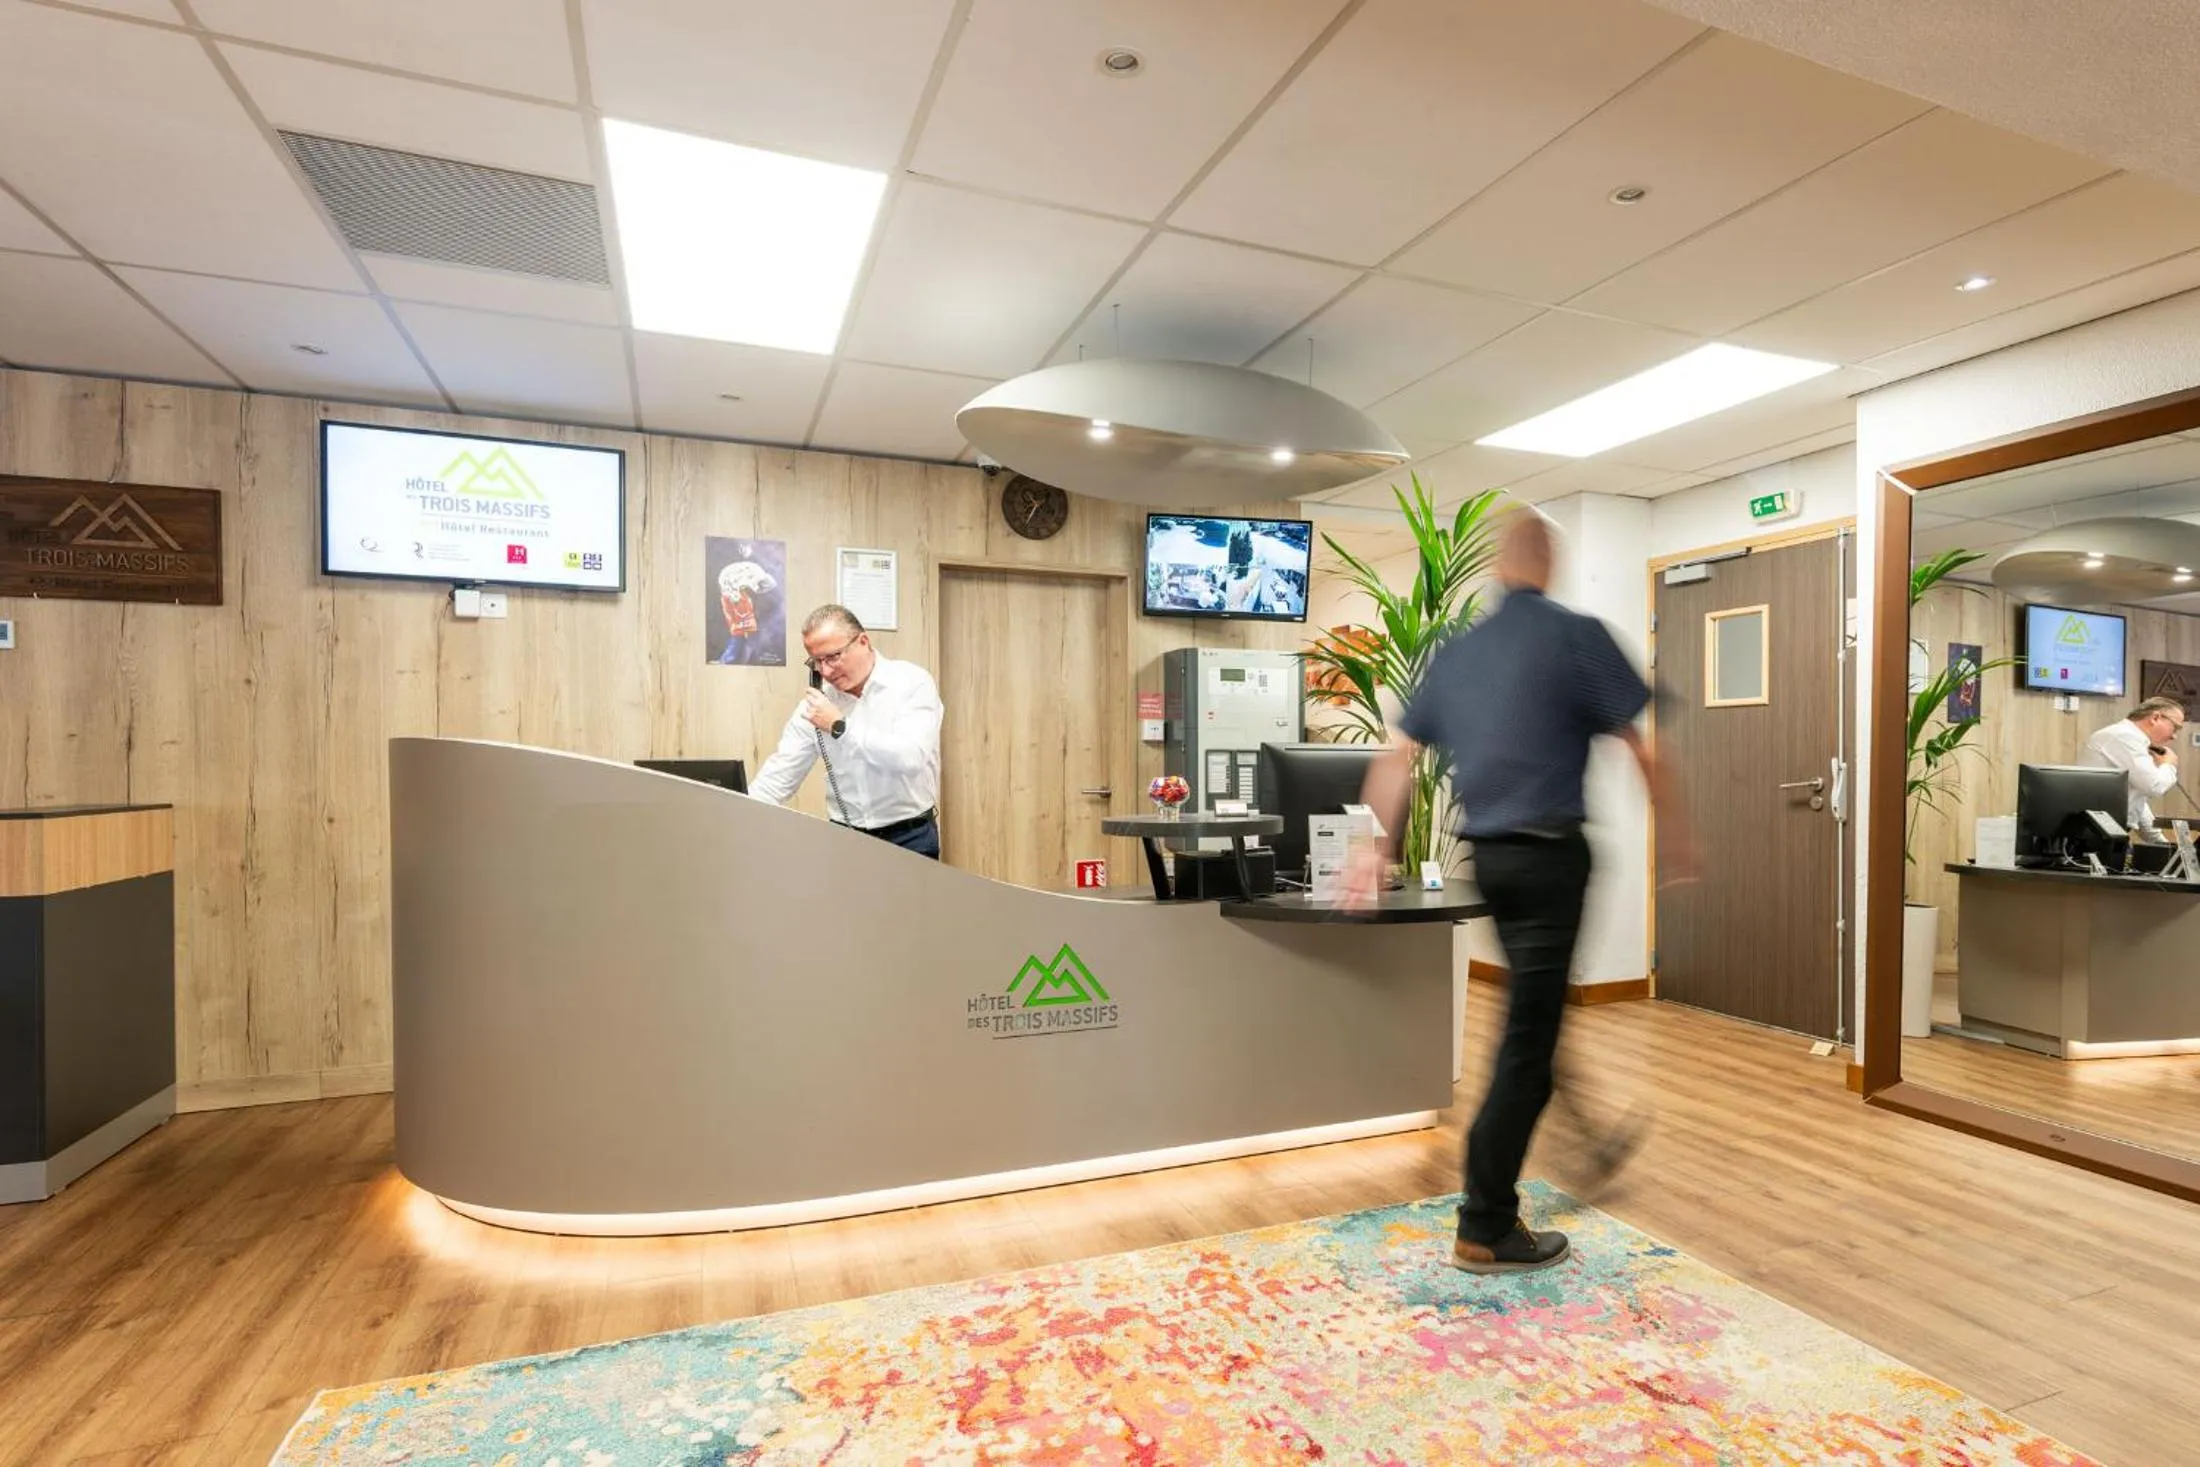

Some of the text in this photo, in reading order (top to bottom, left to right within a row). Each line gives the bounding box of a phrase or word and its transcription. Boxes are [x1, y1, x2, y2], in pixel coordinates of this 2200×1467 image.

[405, 476, 447, 492] HÔTEL
[420, 495, 551, 519] TROIS MASSIFS
[25, 547, 191, 574] TROIS MASSIFS
[967, 993, 1015, 1012] HÔTEL
[967, 1005, 1119, 1032] DES TROIS MASSIFS
